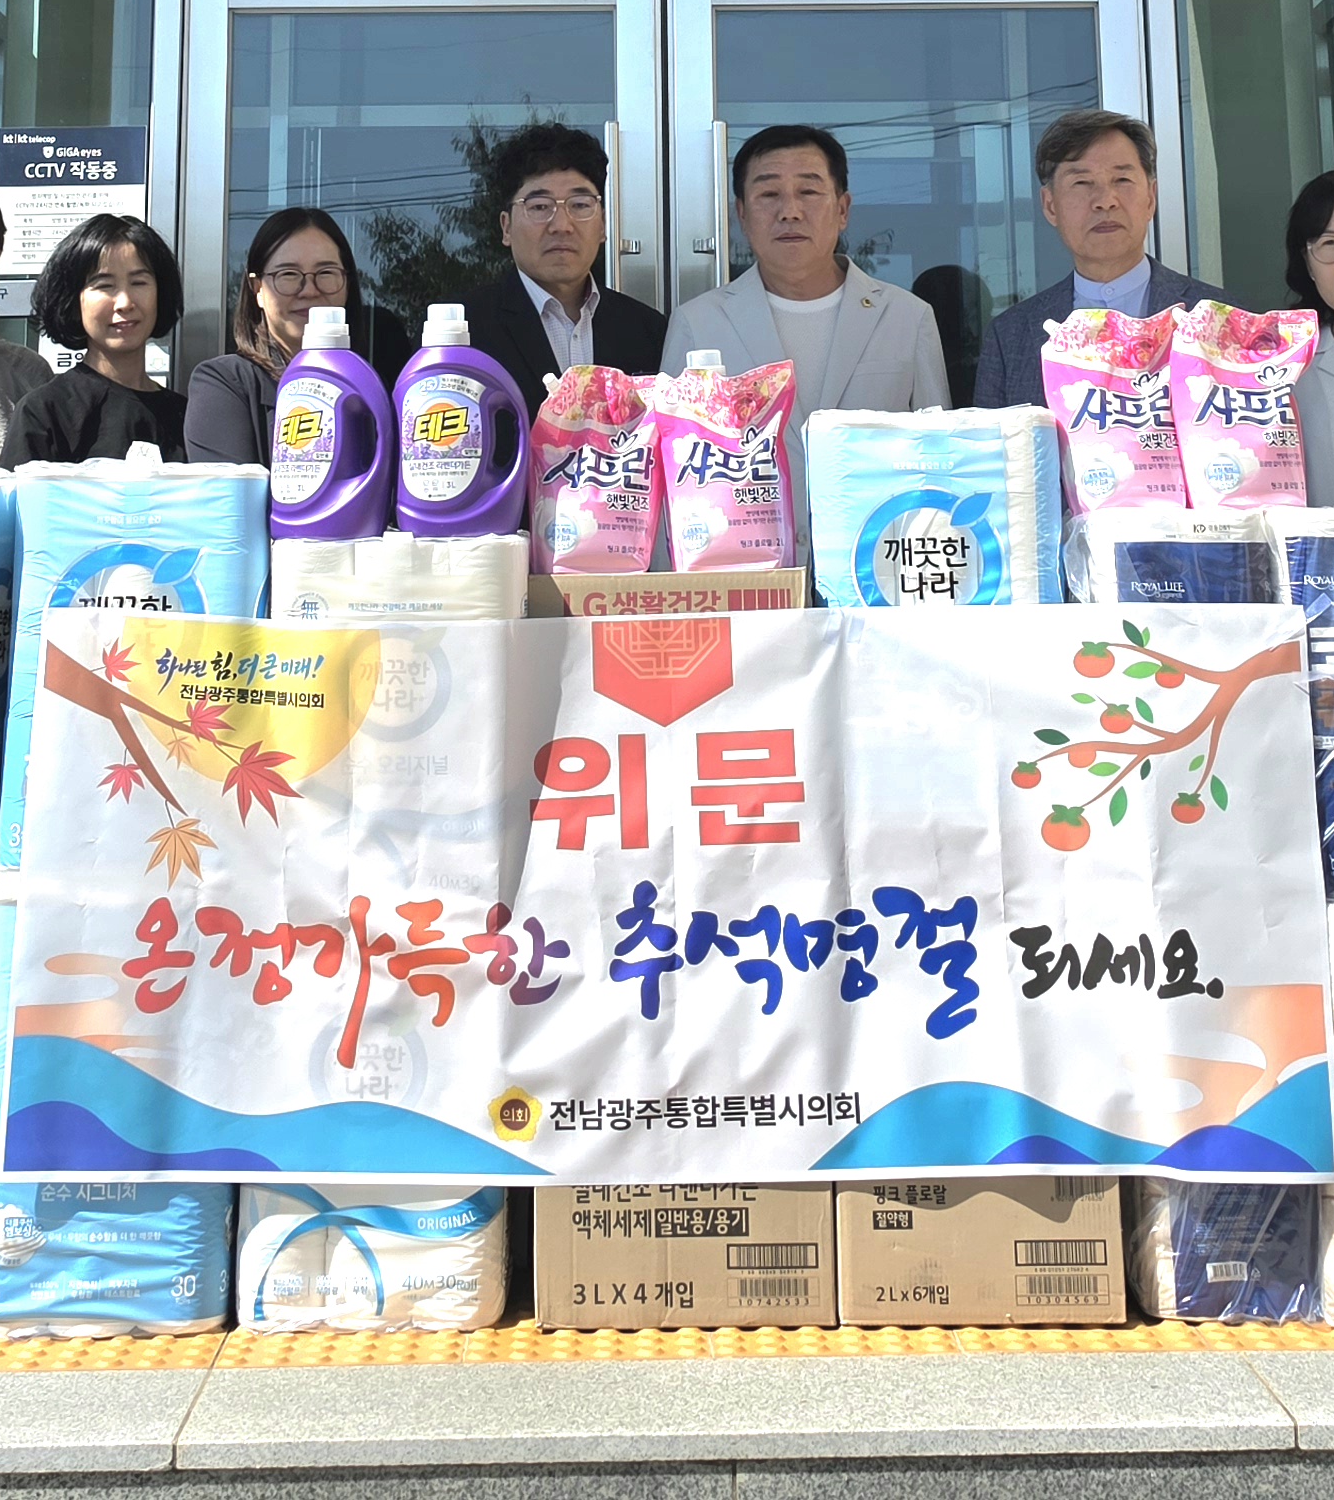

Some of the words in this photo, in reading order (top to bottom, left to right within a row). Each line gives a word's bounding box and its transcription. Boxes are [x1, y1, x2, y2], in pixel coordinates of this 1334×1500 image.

[56, 147, 79, 157] GIGA
[80, 148, 102, 158] eyes
[24, 163, 66, 178] CCTV
[69, 161, 118, 180] 작동중
[277, 410, 323, 447] 테크
[412, 407, 470, 442] 테크
[543, 447, 654, 491] 샤프란
[677, 436, 778, 485] 샤프란
[607, 494, 649, 511] 햇빛건조
[734, 487, 780, 504] 햇빛건조
[884, 537, 970, 568] 깨끗한
[900, 571, 959, 600] 나라
[155, 647, 208, 695] 하나된
[259, 653, 277, 680] 큰
[280, 654, 325, 679] 미래!
[179, 683, 325, 708] 전남광주통합특별시의회
[121, 895, 571, 1068] 온정가득한
[609, 880, 980, 1040] 추석명절
[1010, 926, 1225, 999] 되세요.
[502, 1109, 528, 1123] 의회
[549, 1091, 862, 1131] 전남광주통합특별시의회
[41, 1184, 71, 1201] 순수
[76, 1183, 137, 1201] 시그니처
[873, 1185, 901, 1205] 핑크
[905, 1184, 947, 1204] 플로랄
[417, 1210, 477, 1230] ORIGINAL
[572, 1209, 652, 1239] 액체세제
[657, 1208, 747, 1236] 일반용/용기
[875, 1211, 909, 1228] 절약형
[171, 1275, 196, 1297] 30
